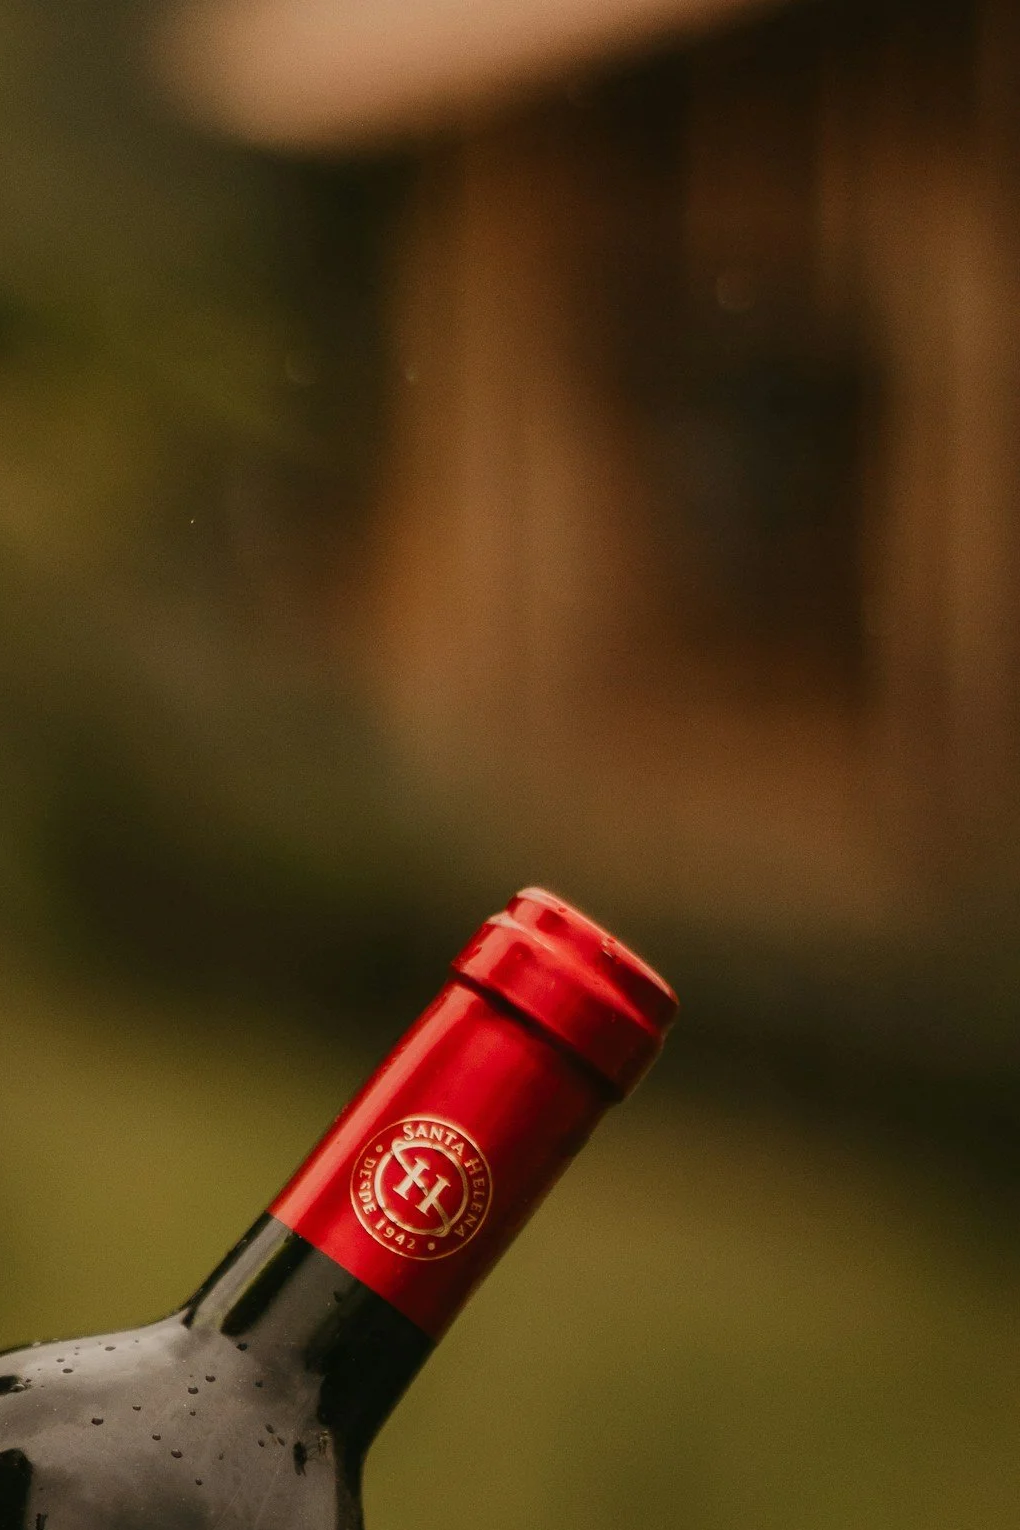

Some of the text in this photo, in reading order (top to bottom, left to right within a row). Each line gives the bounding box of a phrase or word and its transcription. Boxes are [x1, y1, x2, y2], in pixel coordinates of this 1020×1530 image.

[359, 1156, 417, 1250] DESDE 1942
[403, 1123, 486, 1237] SANTA HELENA
